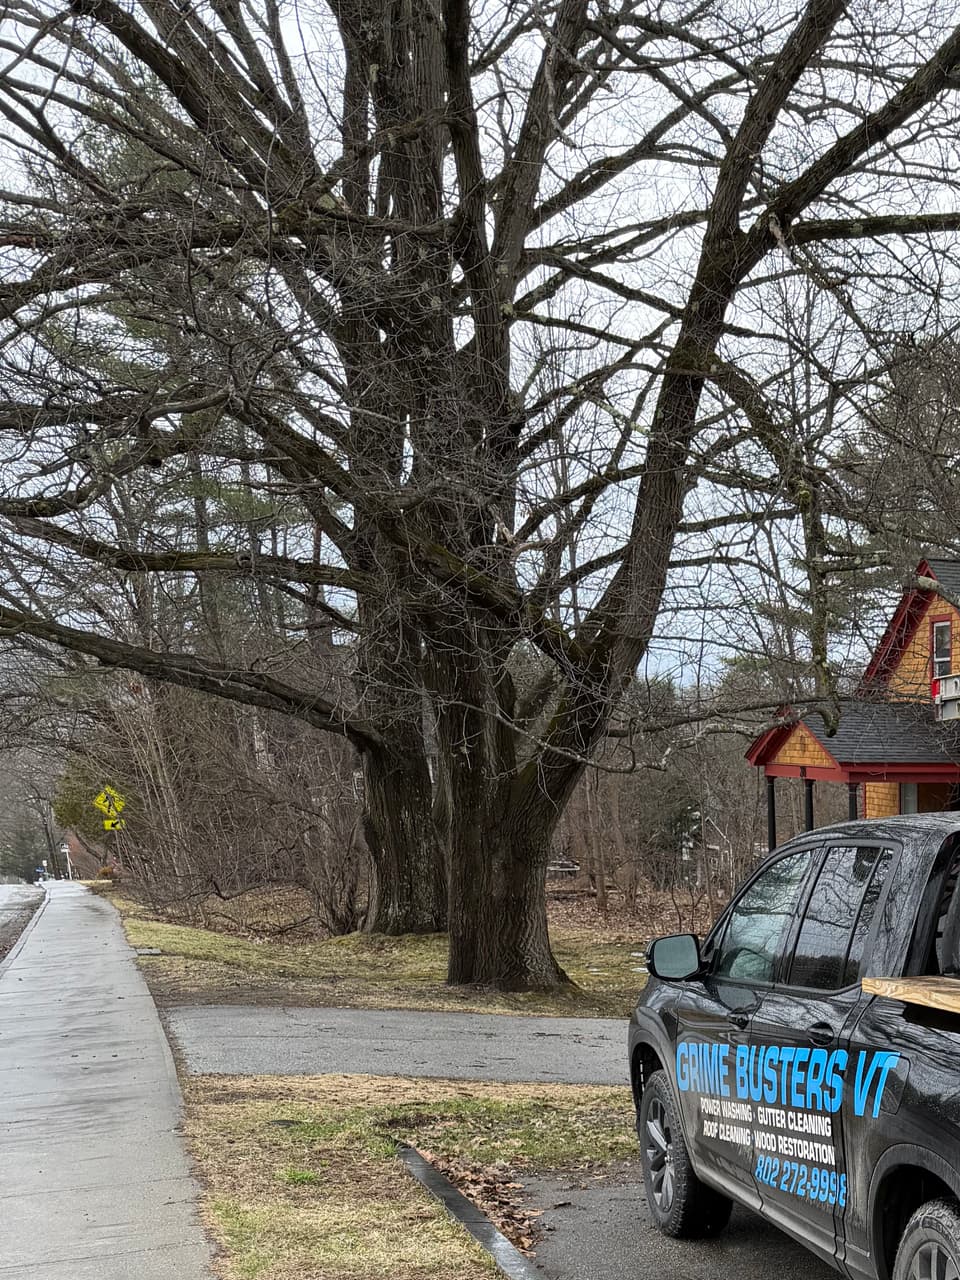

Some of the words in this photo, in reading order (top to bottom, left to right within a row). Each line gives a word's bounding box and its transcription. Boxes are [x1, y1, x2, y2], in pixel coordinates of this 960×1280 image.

[676, 1041, 731, 1097] GRIME
[735, 1044, 848, 1114] BUSTERS
[854, 1050, 901, 1119] VT
[700, 1097, 722, 1118] POWER
[721, 1100, 753, 1122] WASHING
[757, 1106, 787, 1129] GUTTER
[787, 1110, 832, 1137] CLEANING
[703, 1119, 719, 1138] ROOF
[718, 1123, 751, 1146] CLEANING
[754, 1130, 777, 1152] WOOD
[778, 1135, 836, 1166] RESTORATION
